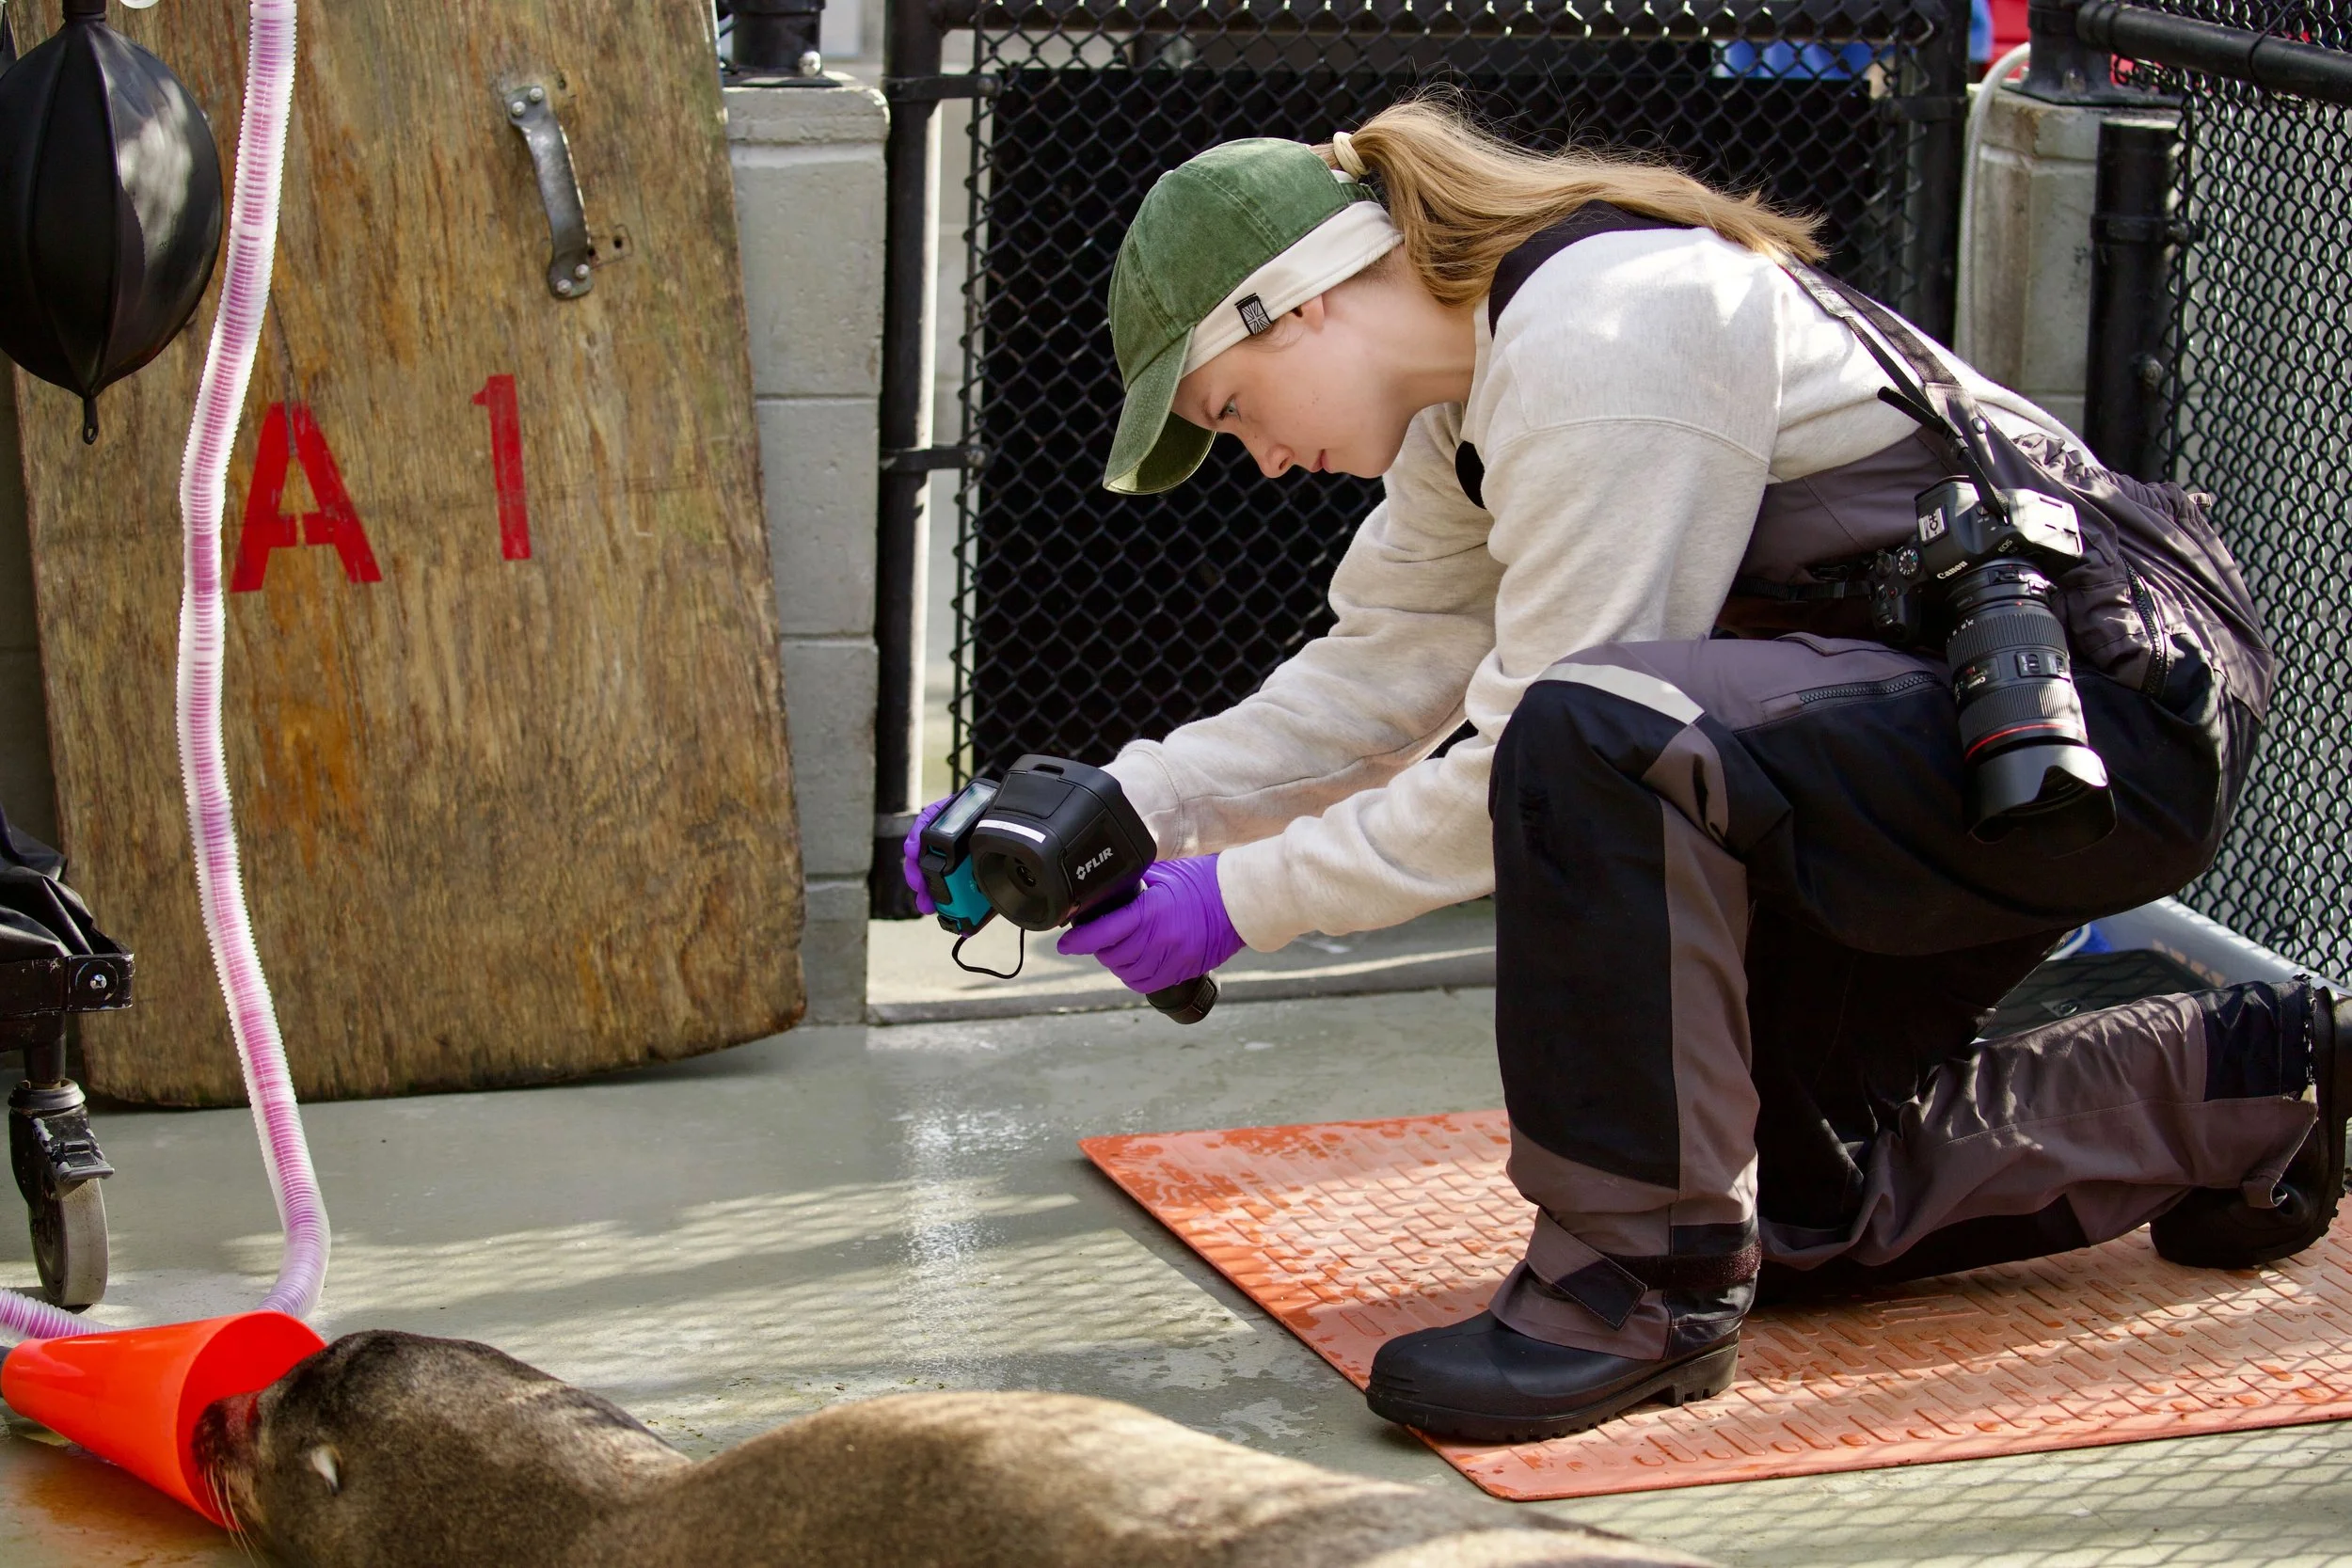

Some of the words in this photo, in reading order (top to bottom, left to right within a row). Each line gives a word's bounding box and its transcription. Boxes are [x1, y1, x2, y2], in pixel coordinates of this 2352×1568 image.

[230, 402, 382, 594] A
[472, 373, 532, 562] 1
[1998, 539, 2013, 553] EOS
[1936, 561, 1969, 579] Canon
[1085, 847, 1114, 873] FLIR
